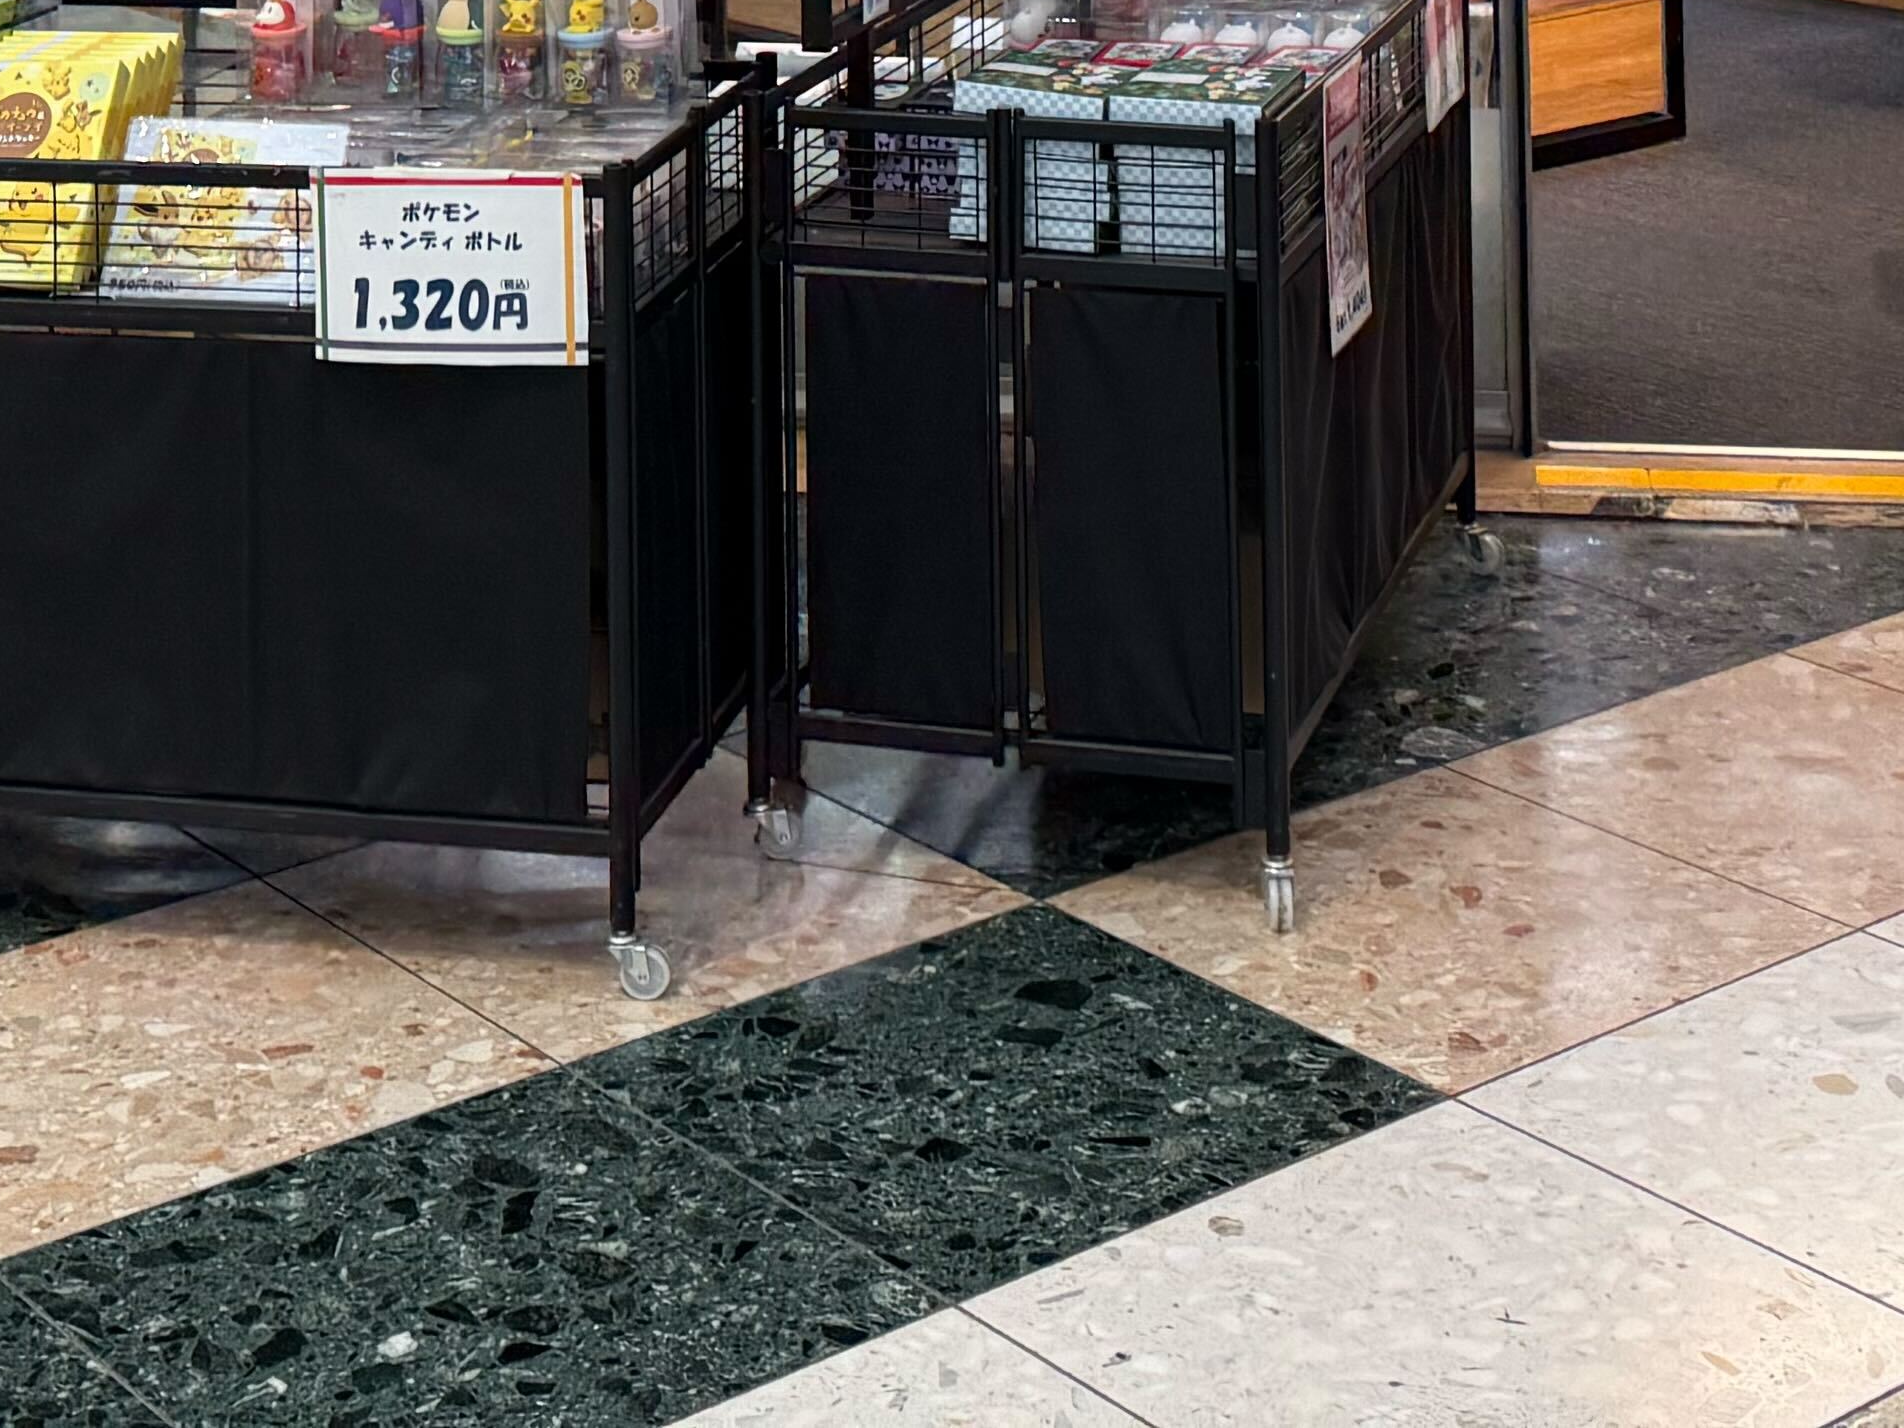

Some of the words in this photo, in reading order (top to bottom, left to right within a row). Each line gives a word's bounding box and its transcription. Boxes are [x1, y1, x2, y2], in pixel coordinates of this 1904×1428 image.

[401, 202, 481, 224] ポケモン
[358, 229, 454, 252] キャンディ
[353, 276, 530, 332] 1,320円
